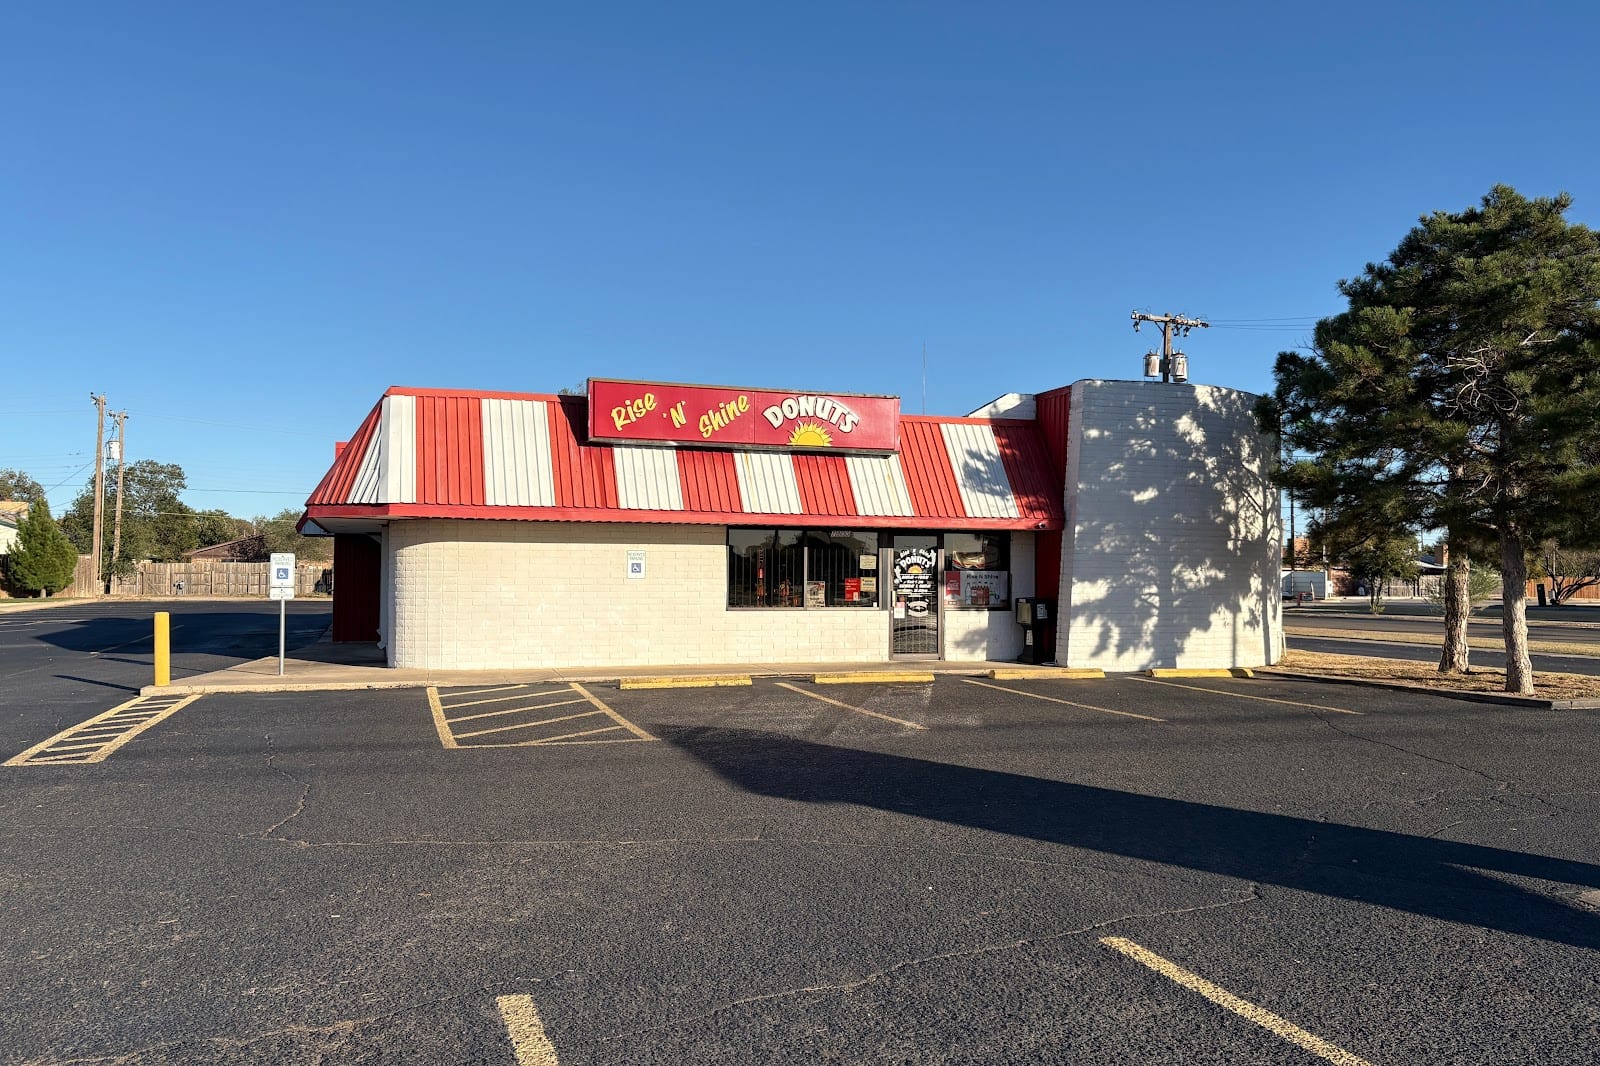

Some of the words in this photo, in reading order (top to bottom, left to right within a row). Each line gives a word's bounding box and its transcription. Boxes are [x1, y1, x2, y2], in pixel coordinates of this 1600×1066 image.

[610, 392, 657, 431] Rise
[698, 394, 751, 439] Shine
[762, 395, 860, 433] DONUTS
[900, 556, 930, 568] DONUTS
